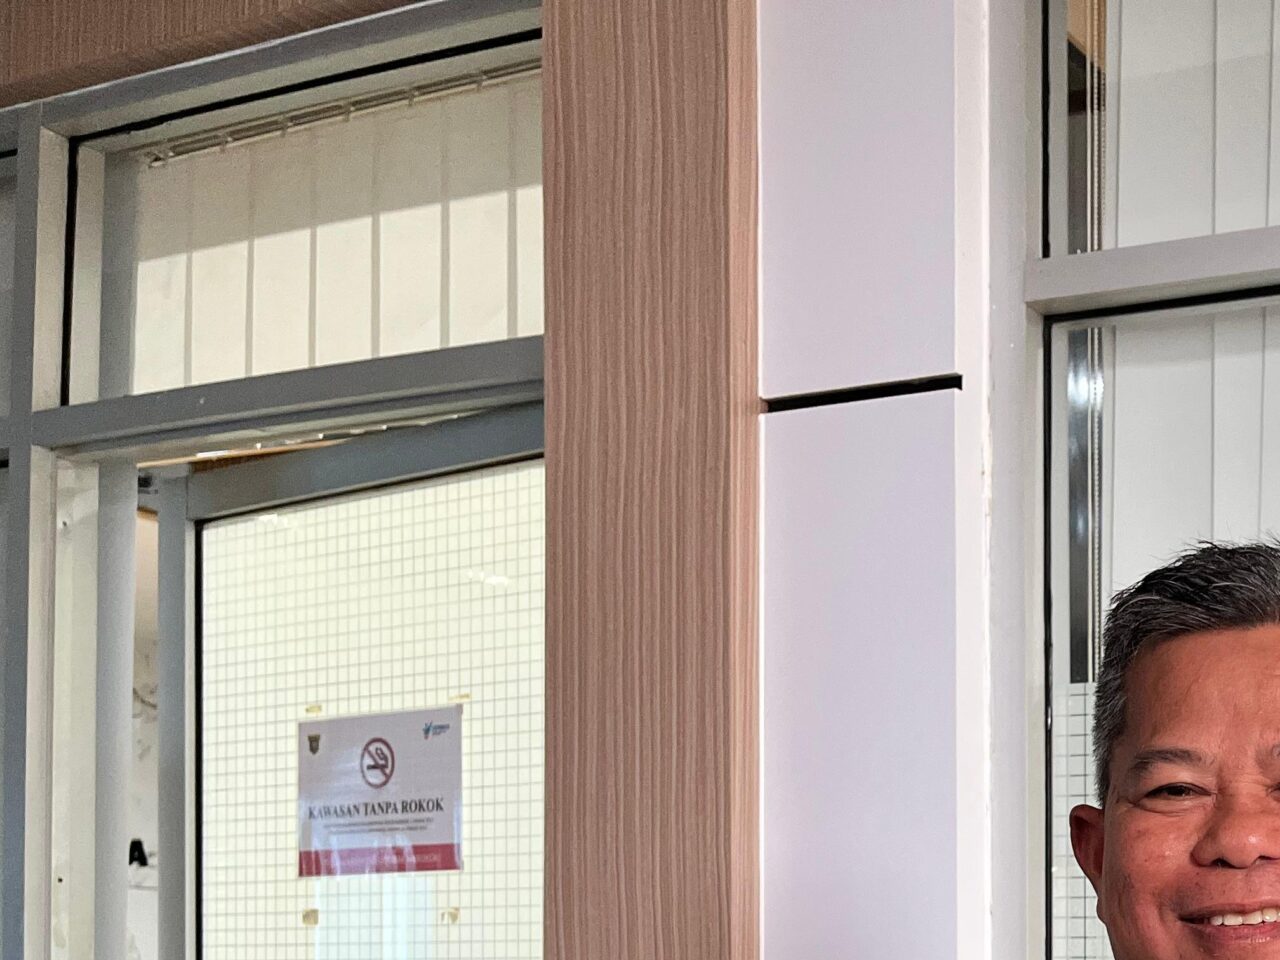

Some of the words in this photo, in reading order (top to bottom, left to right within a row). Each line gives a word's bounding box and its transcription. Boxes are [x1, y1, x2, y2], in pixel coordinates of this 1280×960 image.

[308, 804, 361, 819] KAWASAN
[364, 801, 399, 816] TANPA
[401, 797, 444, 814] ROKOK
